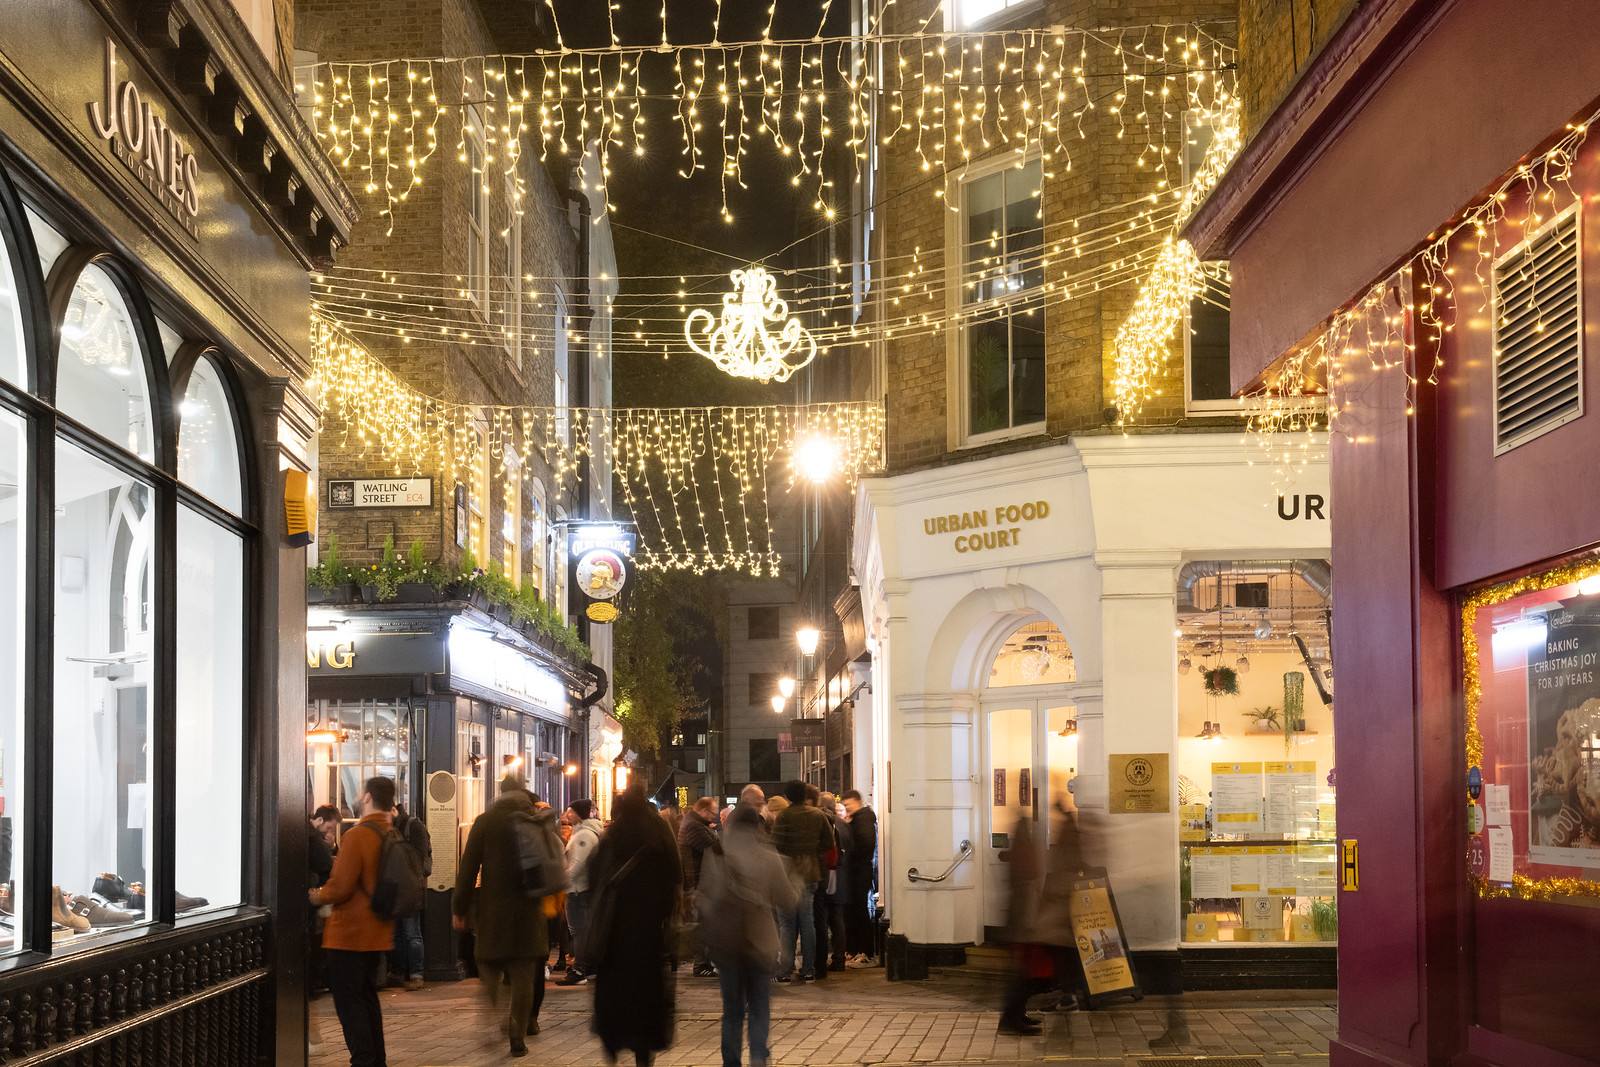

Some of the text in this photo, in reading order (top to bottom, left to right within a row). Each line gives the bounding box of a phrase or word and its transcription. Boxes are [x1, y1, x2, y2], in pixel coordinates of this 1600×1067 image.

[86, 36, 198, 216] JONES
[117, 140, 199, 240] BOOTMAKER
[363, 483, 408, 492] WATLING
[363, 494, 424, 503] STREET EC4
[924, 500, 1049, 535] URBAN FOOD
[954, 528, 1021, 553] COURT
[1547, 637, 1579, 654] BAKING
[1534, 652, 1597, 673] CHRISTMAS JOY
[1538, 671, 1593, 690] FOR 30 YEARS
[1472, 849, 1483, 866] 25
